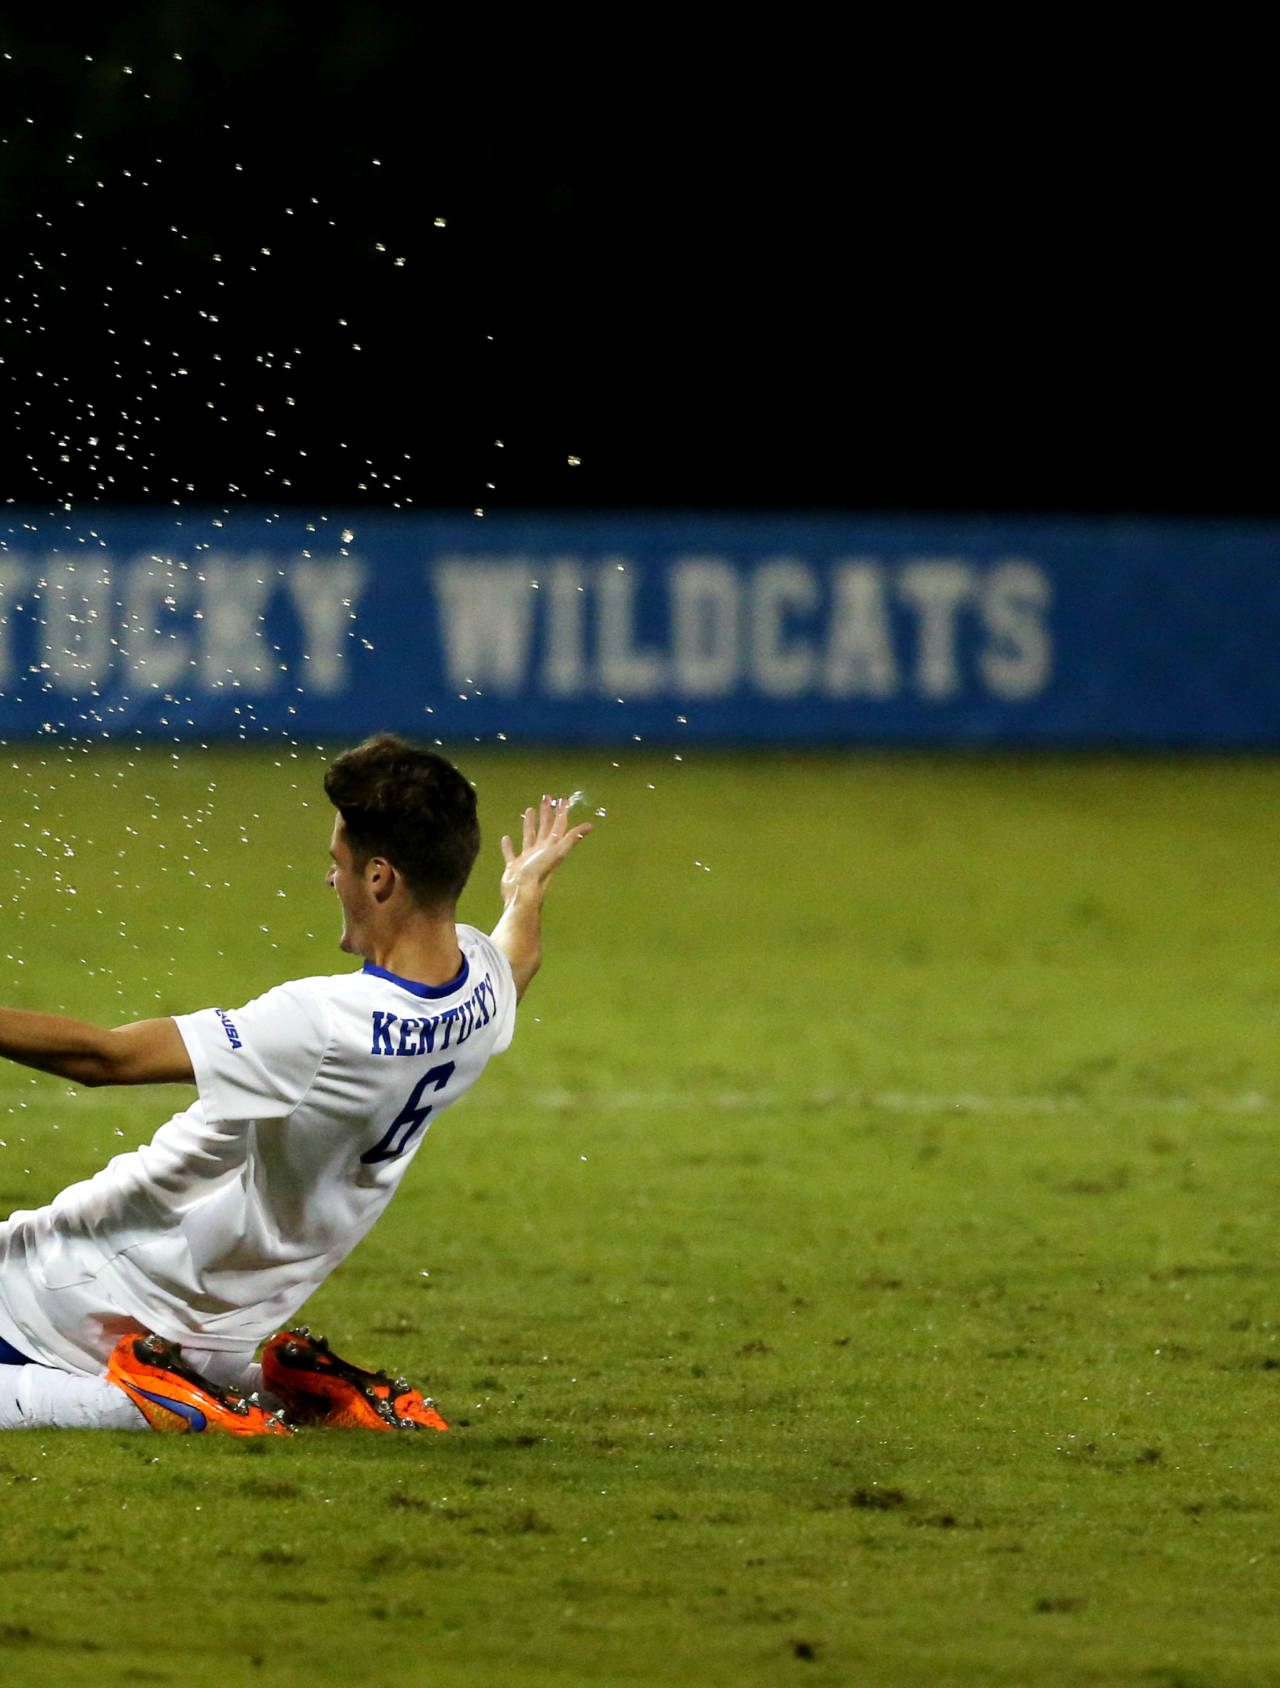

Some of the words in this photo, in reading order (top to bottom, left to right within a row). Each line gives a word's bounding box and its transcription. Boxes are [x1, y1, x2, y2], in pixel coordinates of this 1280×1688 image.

[432, 557, 1052, 697] WILDCATS
[371, 972, 497, 1056] KENTUKY
[360, 1060, 456, 1164] 6
